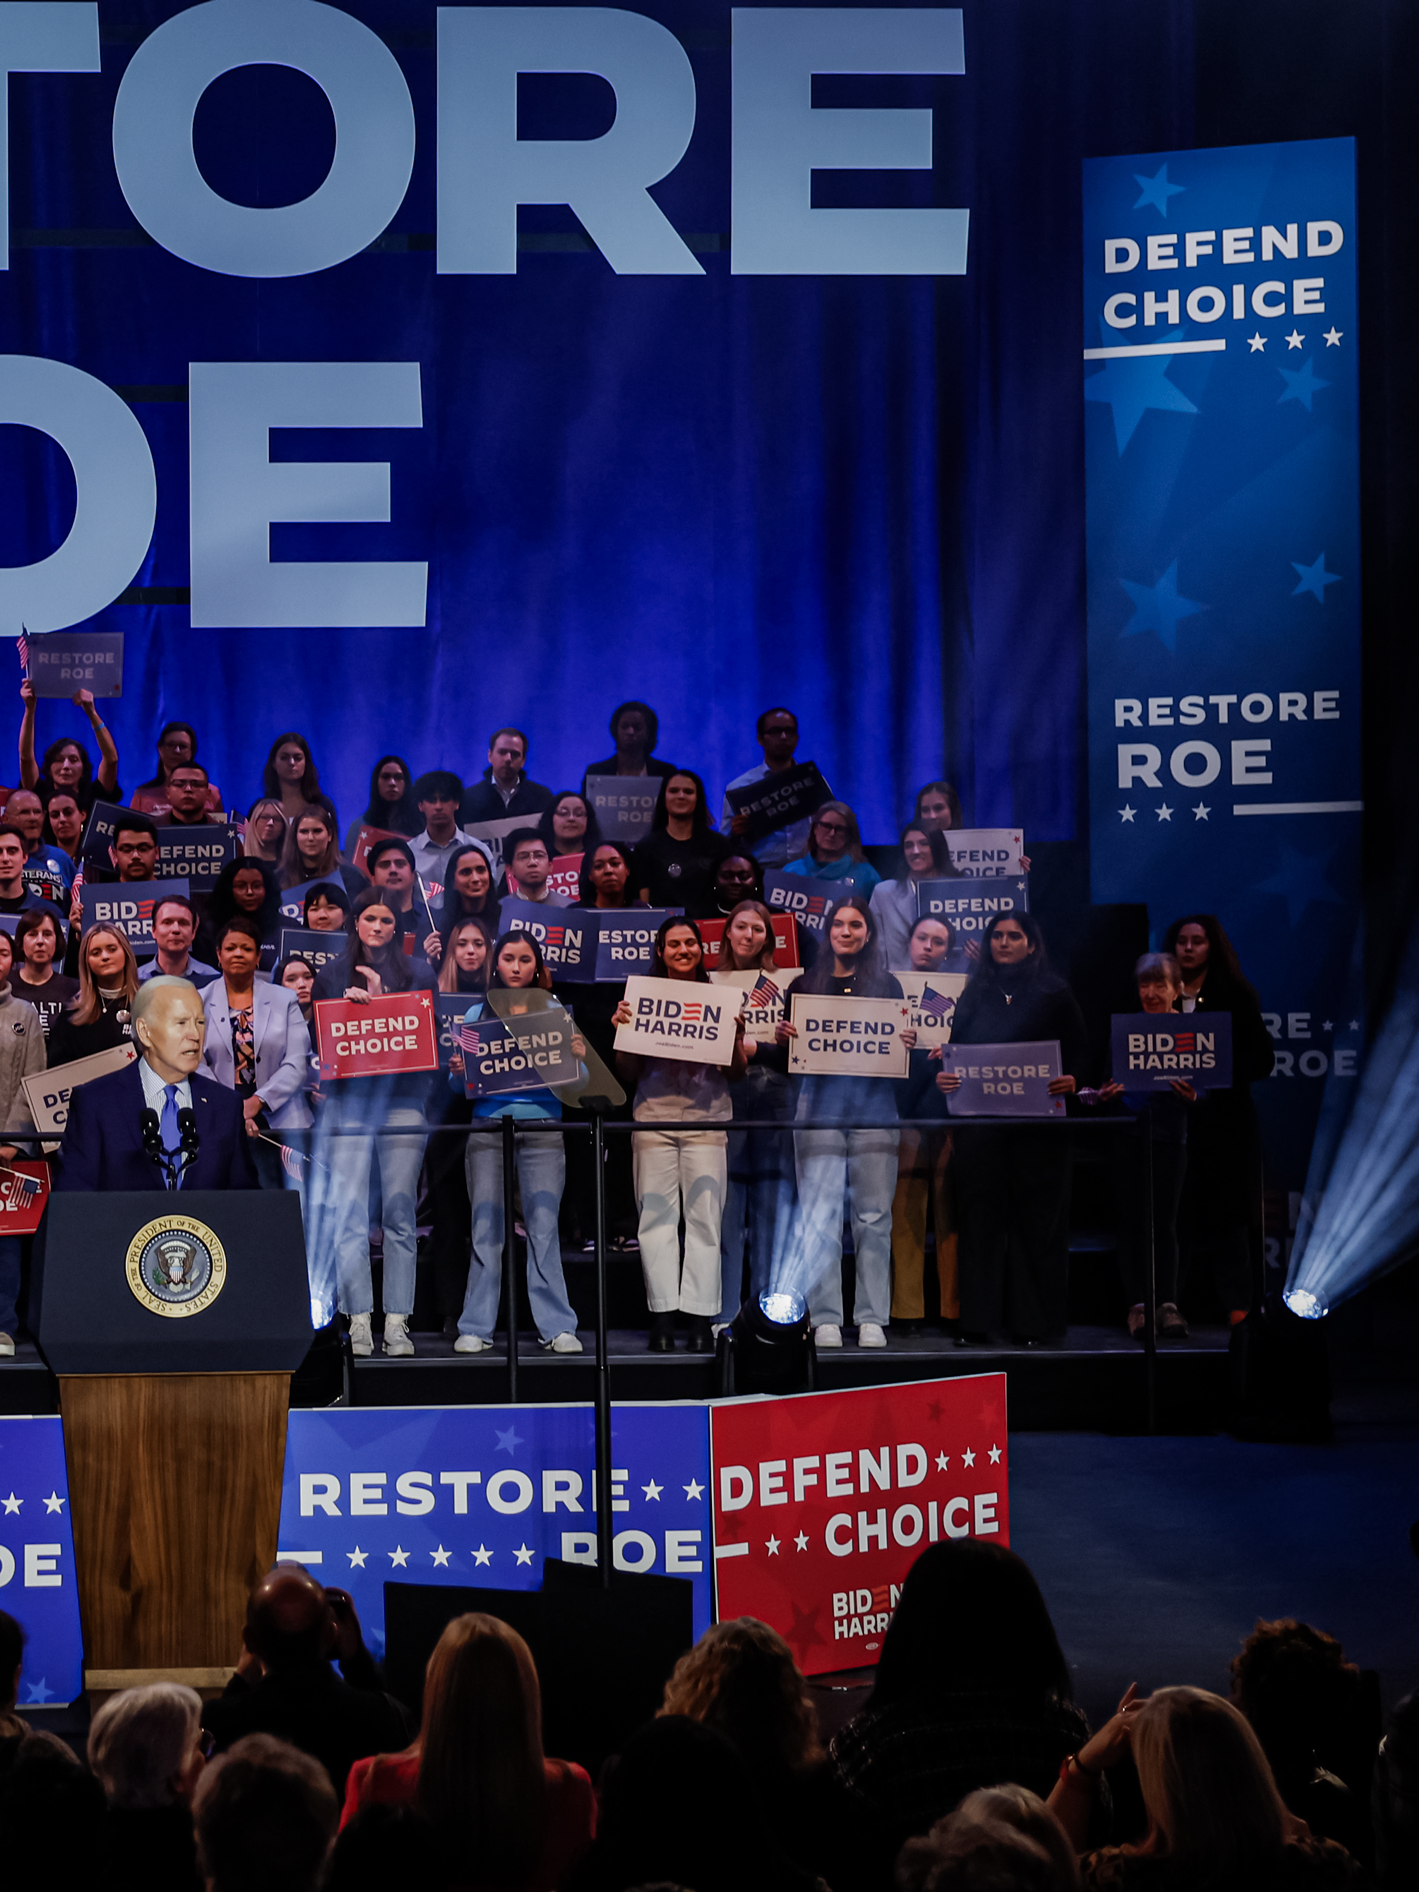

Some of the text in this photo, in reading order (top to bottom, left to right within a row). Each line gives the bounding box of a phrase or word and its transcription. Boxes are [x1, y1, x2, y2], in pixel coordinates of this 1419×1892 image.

[1103, 220, 1344, 274] DEFEND
[1102, 277, 1325, 329] CHOICE
[38, 652, 115, 665] RESTORE
[60, 667, 94, 680] ROE
[1114, 689, 1341, 728] RESTORE
[1117, 738, 1274, 789] ROE
[595, 795, 658, 808] RESTO
[740, 776, 816, 817] RESTORE
[766, 795, 802, 818] ROE
[617, 811, 652, 823] ROE
[160, 844, 225, 859] EFEND
[95, 899, 156, 920] BIDE
[930, 897, 1014, 914] DEFEND
[611, 946, 651, 960] ROE
[637, 997, 721, 1024] BIDEN
[331, 1015, 420, 1038] DEFEND
[634, 1017, 719, 1041] HARRIS
[805, 1018, 895, 1036] DEFEND
[336, 1035, 418, 1057] CHOICE
[476, 1031, 563, 1057] DEFEND
[808, 1038, 891, 1055] CHOICE
[1128, 1032, 1215, 1053] BIDEN
[479, 1050, 562, 1076] CHOICE
[954, 1064, 1051, 1080] RESTORE
[1128, 1052, 1216, 1070] HARRIS
[1269, 1049, 1358, 1078] ROE
[983, 1081, 1025, 1095] ROE
[187, 1222, 201, 1232] THE
[129, 1219, 174, 1263] PRESIDENT
[202, 1231, 223, 1273] UNITED
[142, 1292, 167, 1311] SEAL
[184, 1281, 218, 1312] STATES
[720, 1443, 928, 1512] DEFEND
[299, 1468, 631, 1516] RESTORE
[825, 1492, 999, 1557] CHOICE
[560, 1529, 703, 1574] ROE
[834, 1611, 893, 1640] HARR
